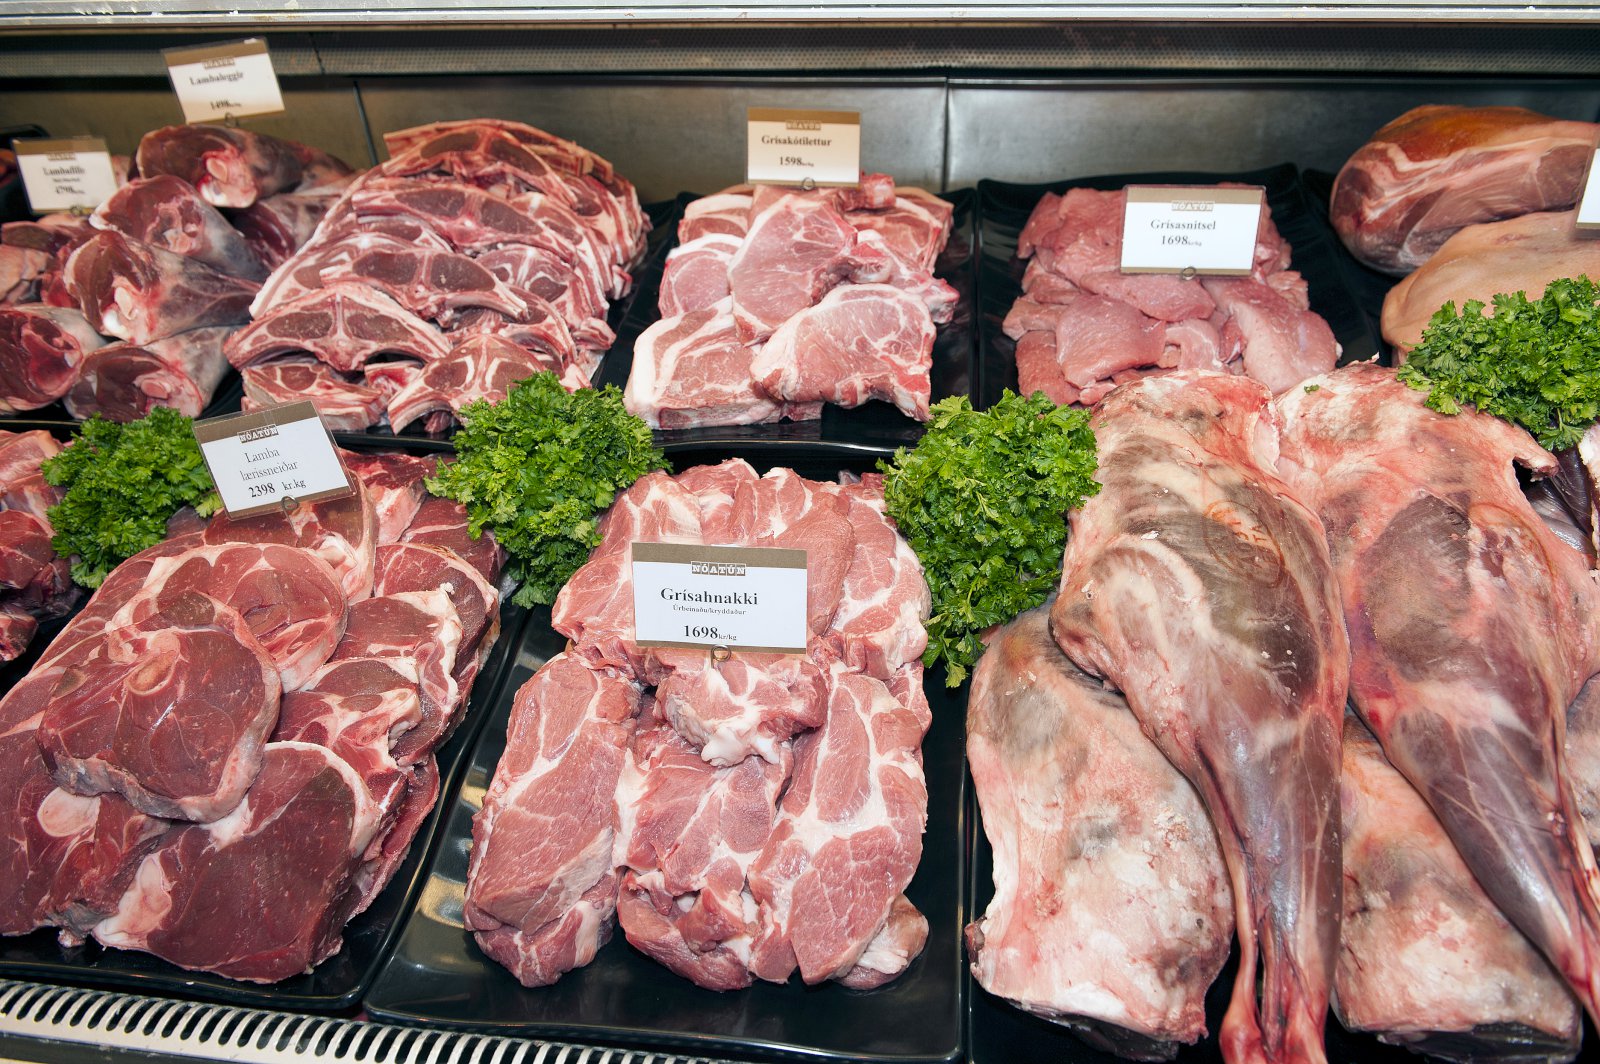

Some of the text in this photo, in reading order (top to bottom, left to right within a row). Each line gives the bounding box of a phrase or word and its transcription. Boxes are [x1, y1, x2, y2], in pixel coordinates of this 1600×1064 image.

[239, 428, 279, 442] NÓATÚN
[244, 447, 280, 463] Lamba
[239, 461, 298, 481] lærissneiðar
[248, 482, 276, 498] 2398
[692, 563, 746, 576] NÓATÚN
[660, 587, 758, 605] Grísahnakki
